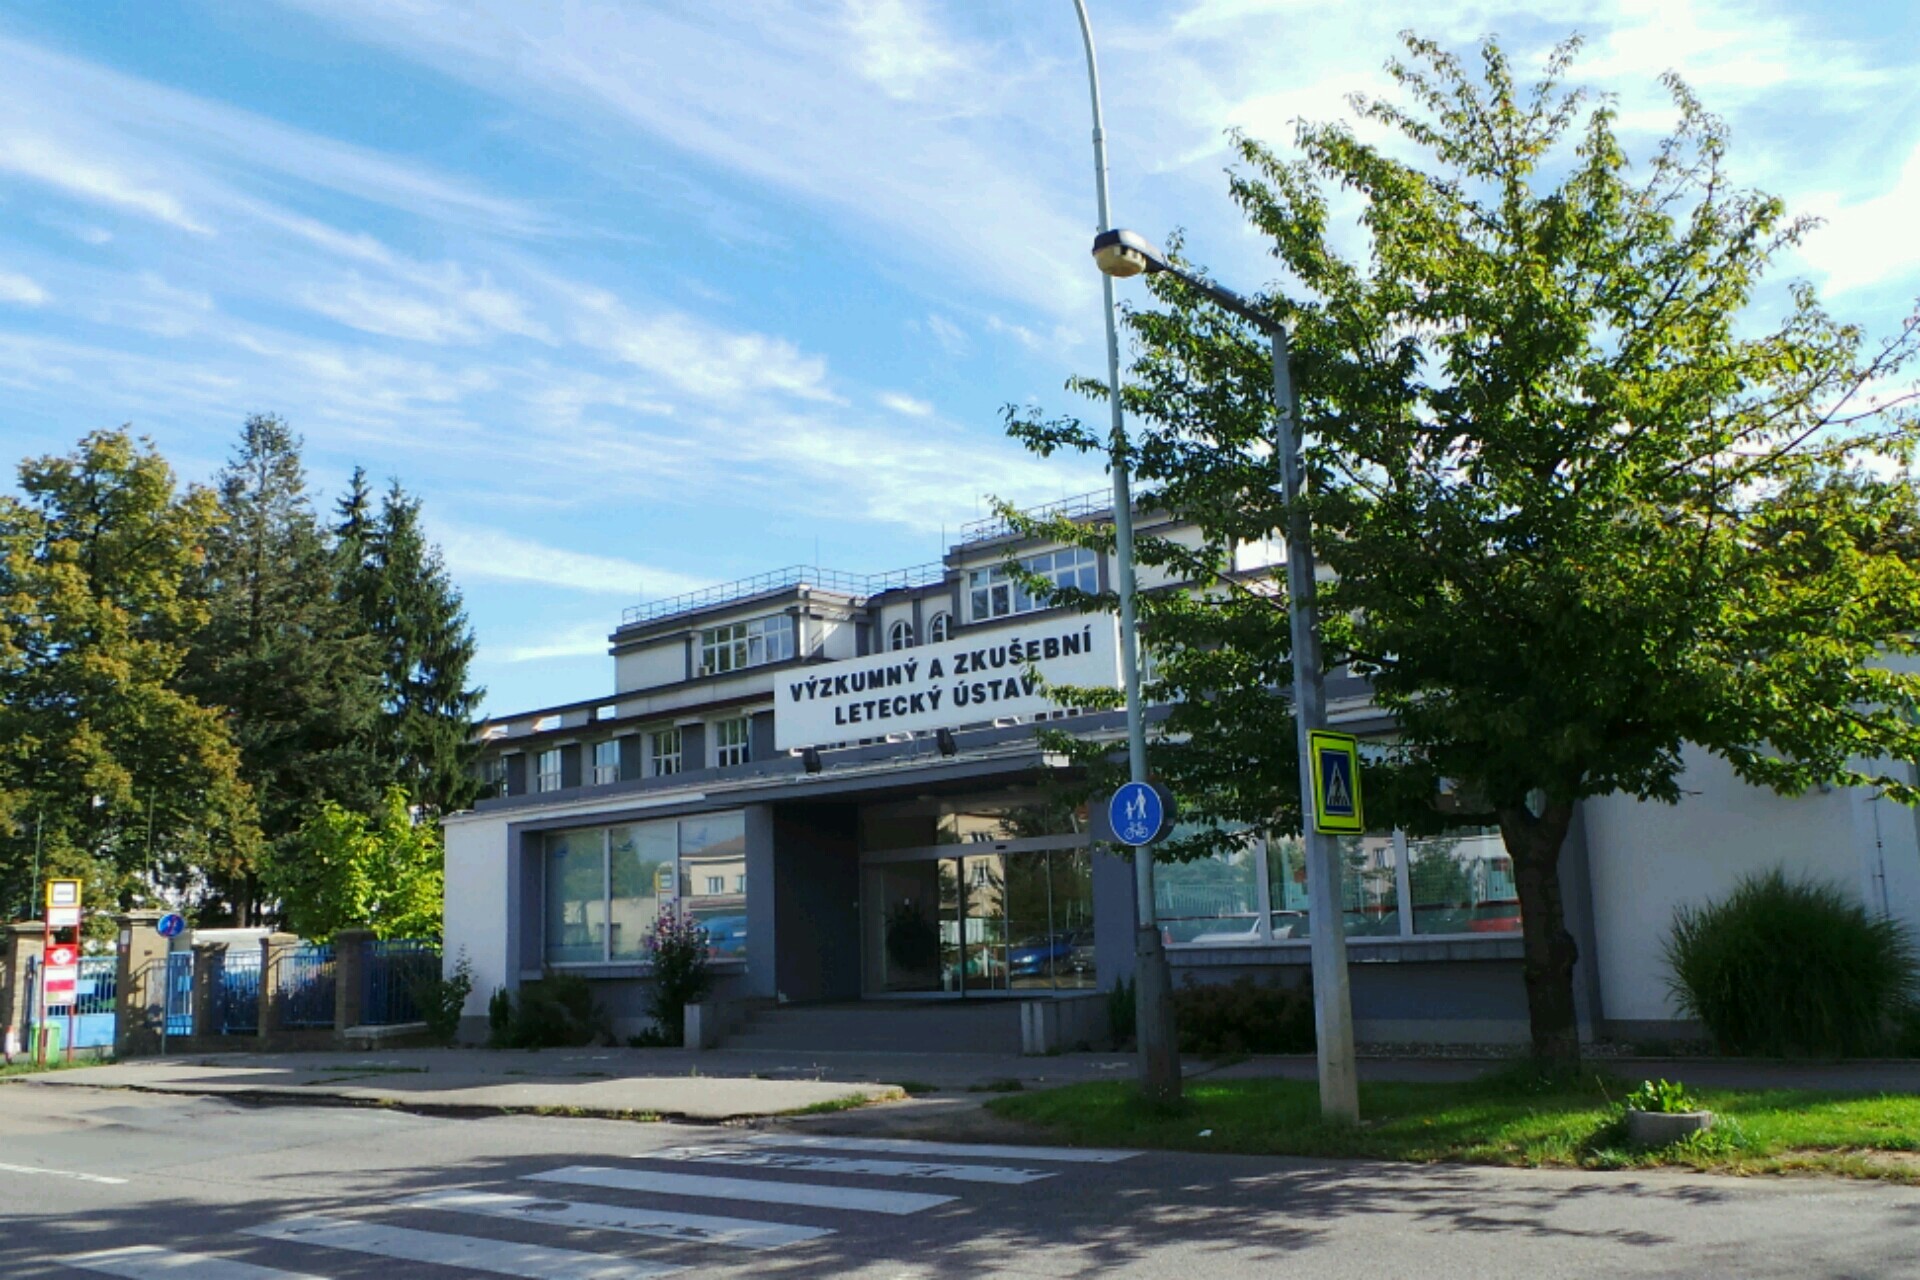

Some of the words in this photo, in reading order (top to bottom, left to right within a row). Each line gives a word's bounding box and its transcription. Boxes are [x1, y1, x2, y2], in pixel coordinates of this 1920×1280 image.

[790, 657, 919, 702] VÝZKUMNÝ
[928, 658, 944, 679] A
[954, 624, 1092, 674] ZKUŠEBNÍ
[835, 684, 942, 725] LETECKÝ
[954, 674, 1035, 706] ÚSTAV
